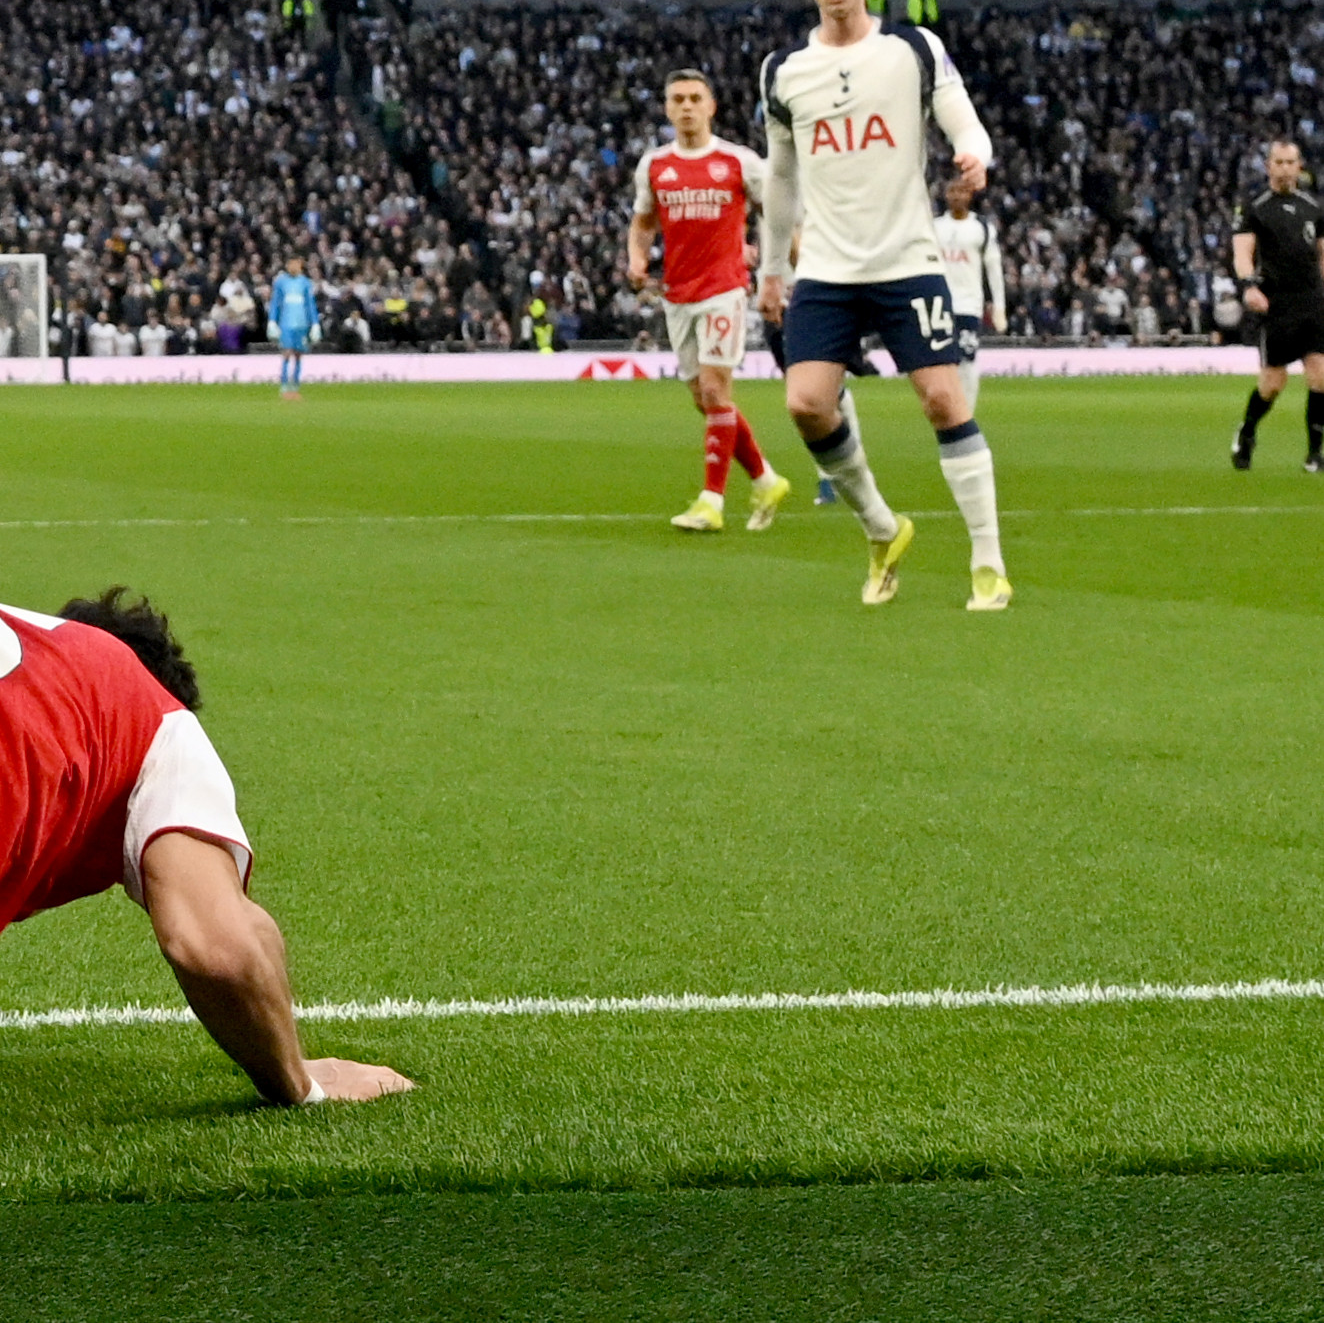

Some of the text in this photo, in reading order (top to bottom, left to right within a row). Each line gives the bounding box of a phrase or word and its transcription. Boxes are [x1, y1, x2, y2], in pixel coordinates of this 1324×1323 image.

[810, 113, 896, 155] AIA
[657, 186, 733, 207] Emirates
[705, 313, 731, 341] 19
[910, 295, 954, 339] 14
